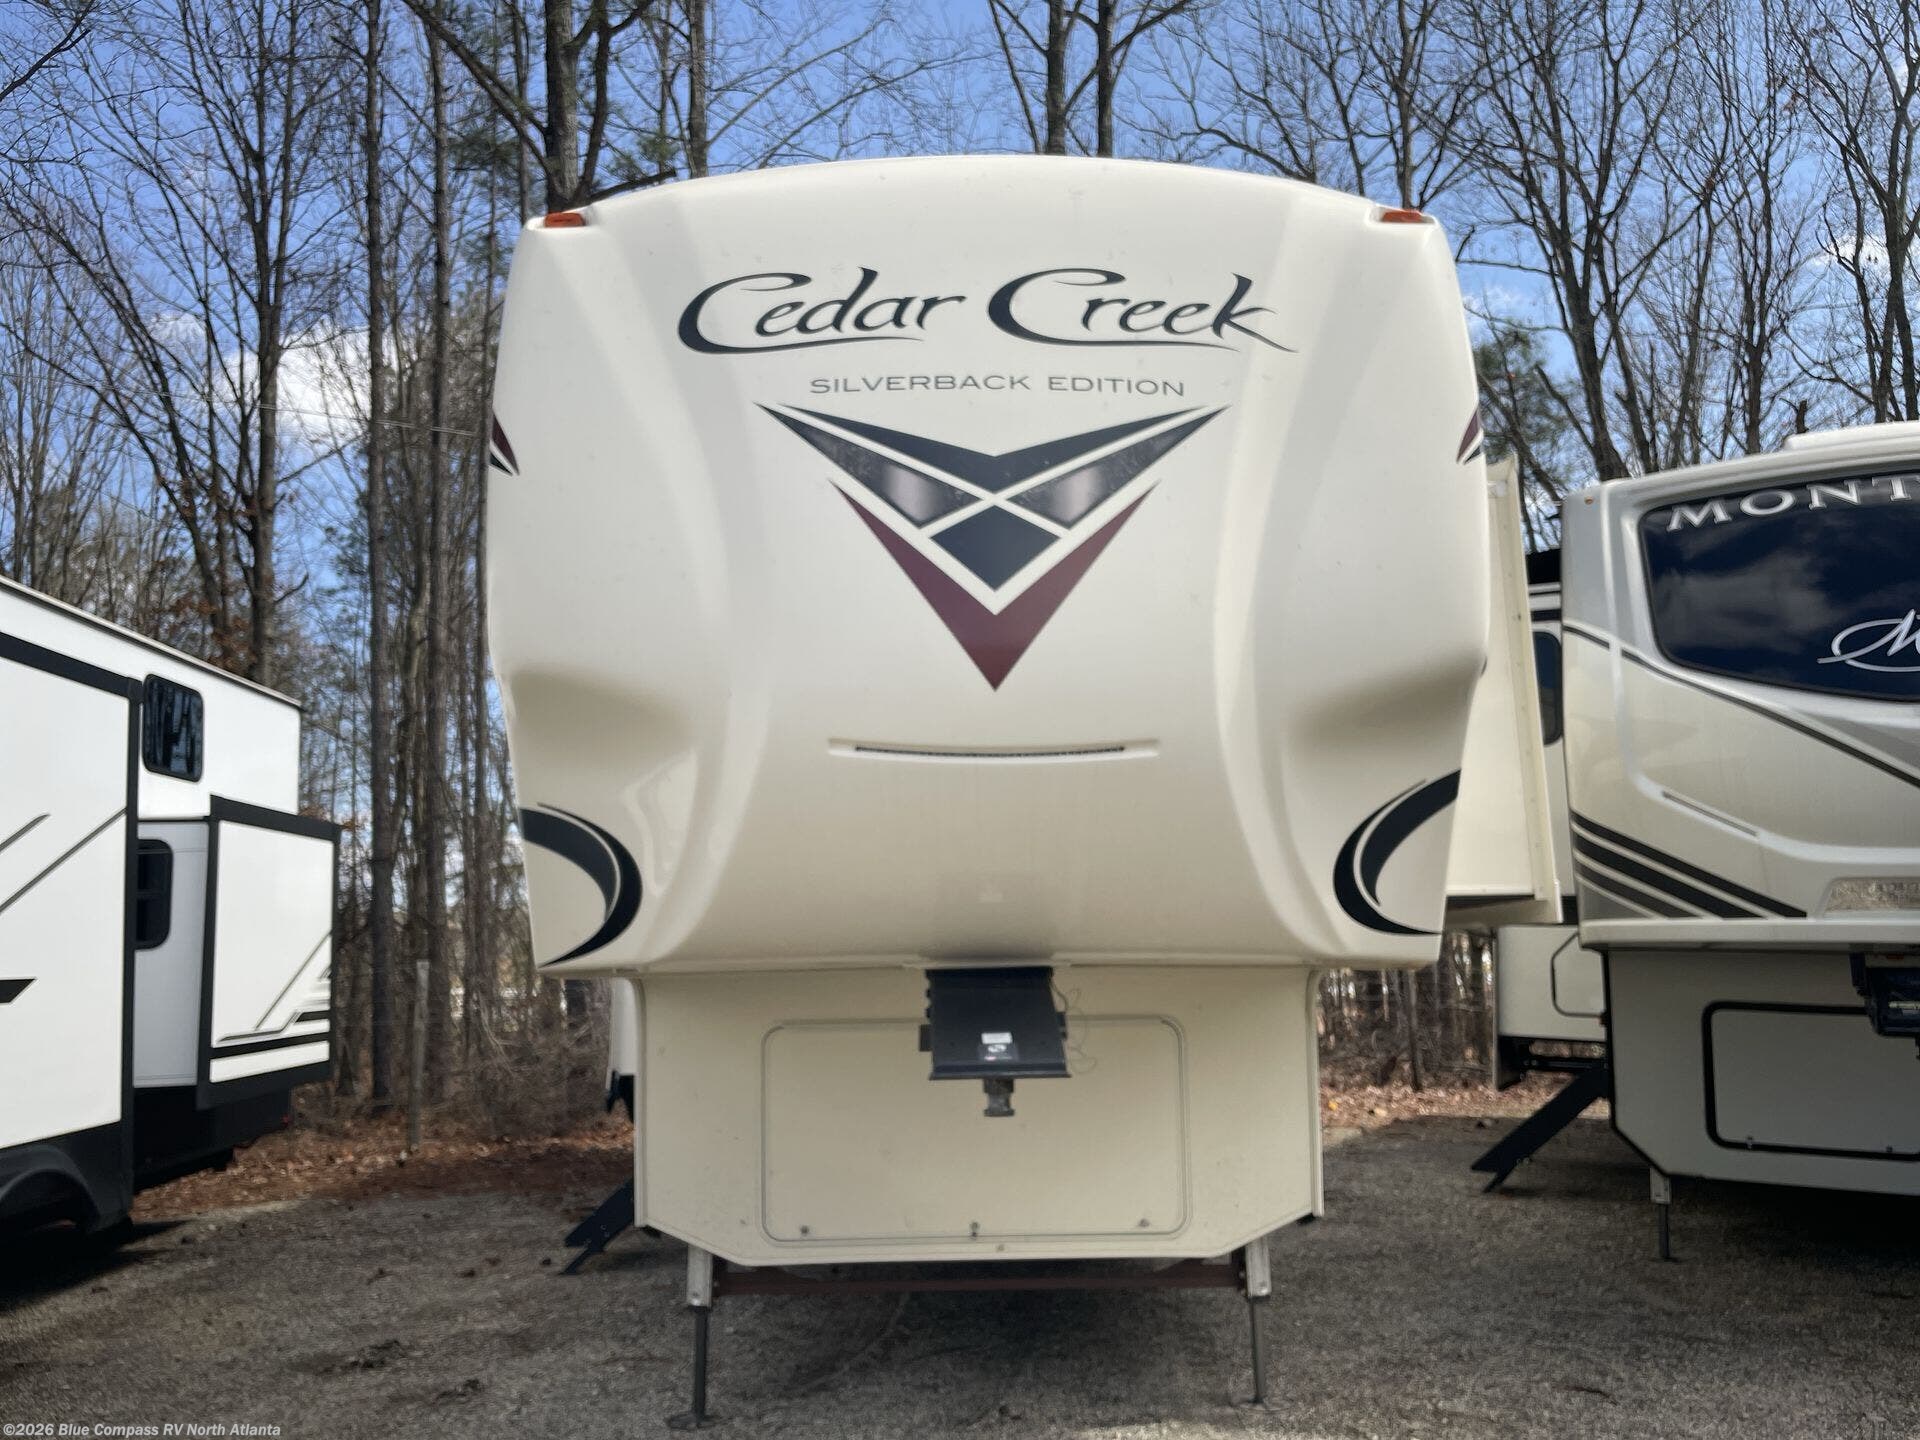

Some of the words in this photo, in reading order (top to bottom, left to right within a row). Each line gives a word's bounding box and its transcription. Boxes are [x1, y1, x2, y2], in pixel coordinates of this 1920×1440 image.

[677, 266, 966, 355] Cedar
[987, 267, 1300, 353] Creek
[810, 375, 1031, 395] SILVERBACK
[1048, 376, 1186, 397] EDITION
